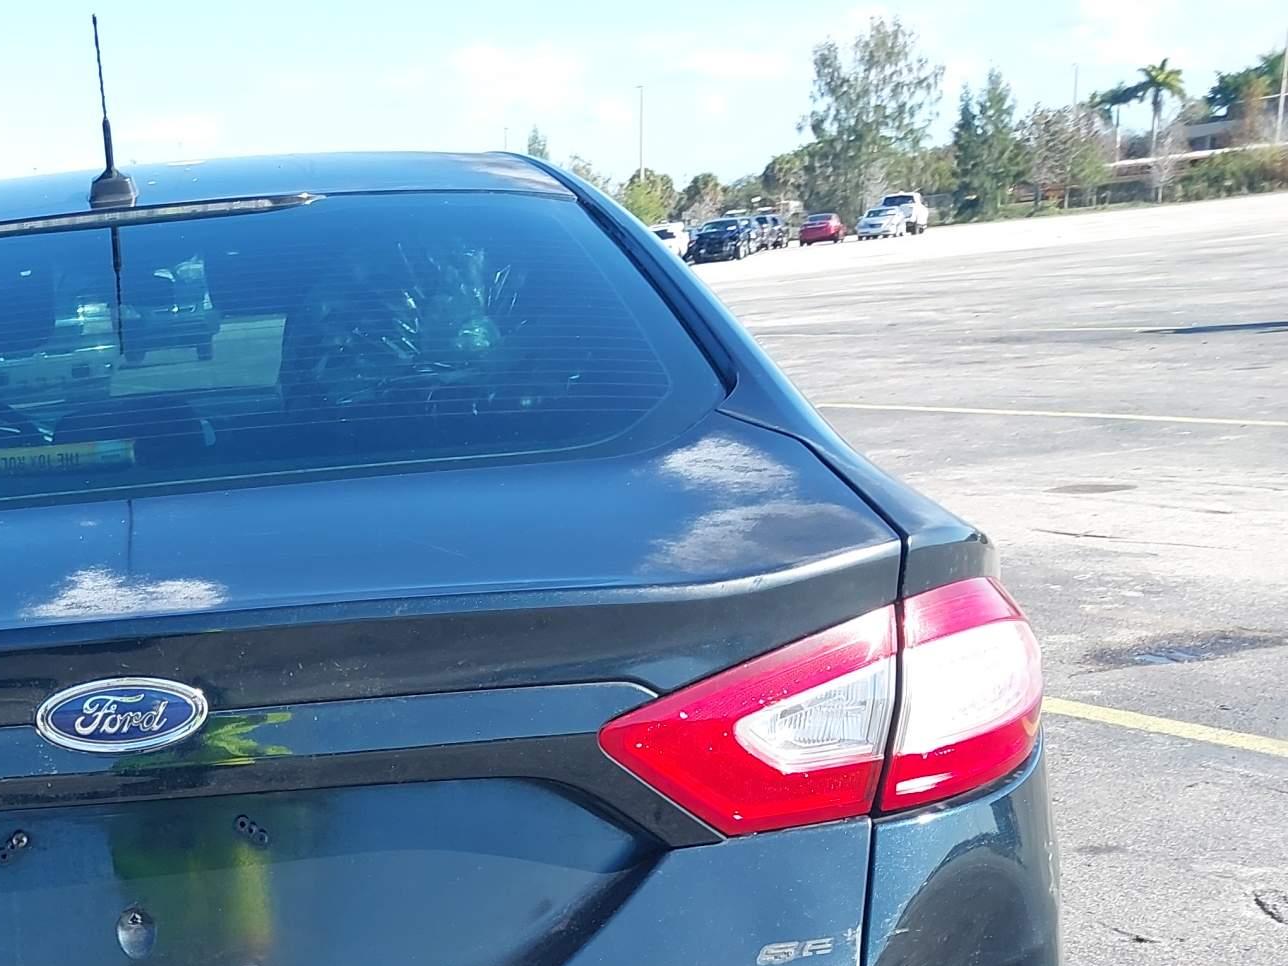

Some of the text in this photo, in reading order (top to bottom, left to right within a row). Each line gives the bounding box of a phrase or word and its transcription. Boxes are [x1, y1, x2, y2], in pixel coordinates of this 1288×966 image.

[56, 452, 81, 469] THE
[74, 693, 169, 736] Ford
[757, 937, 834, 966] SE
